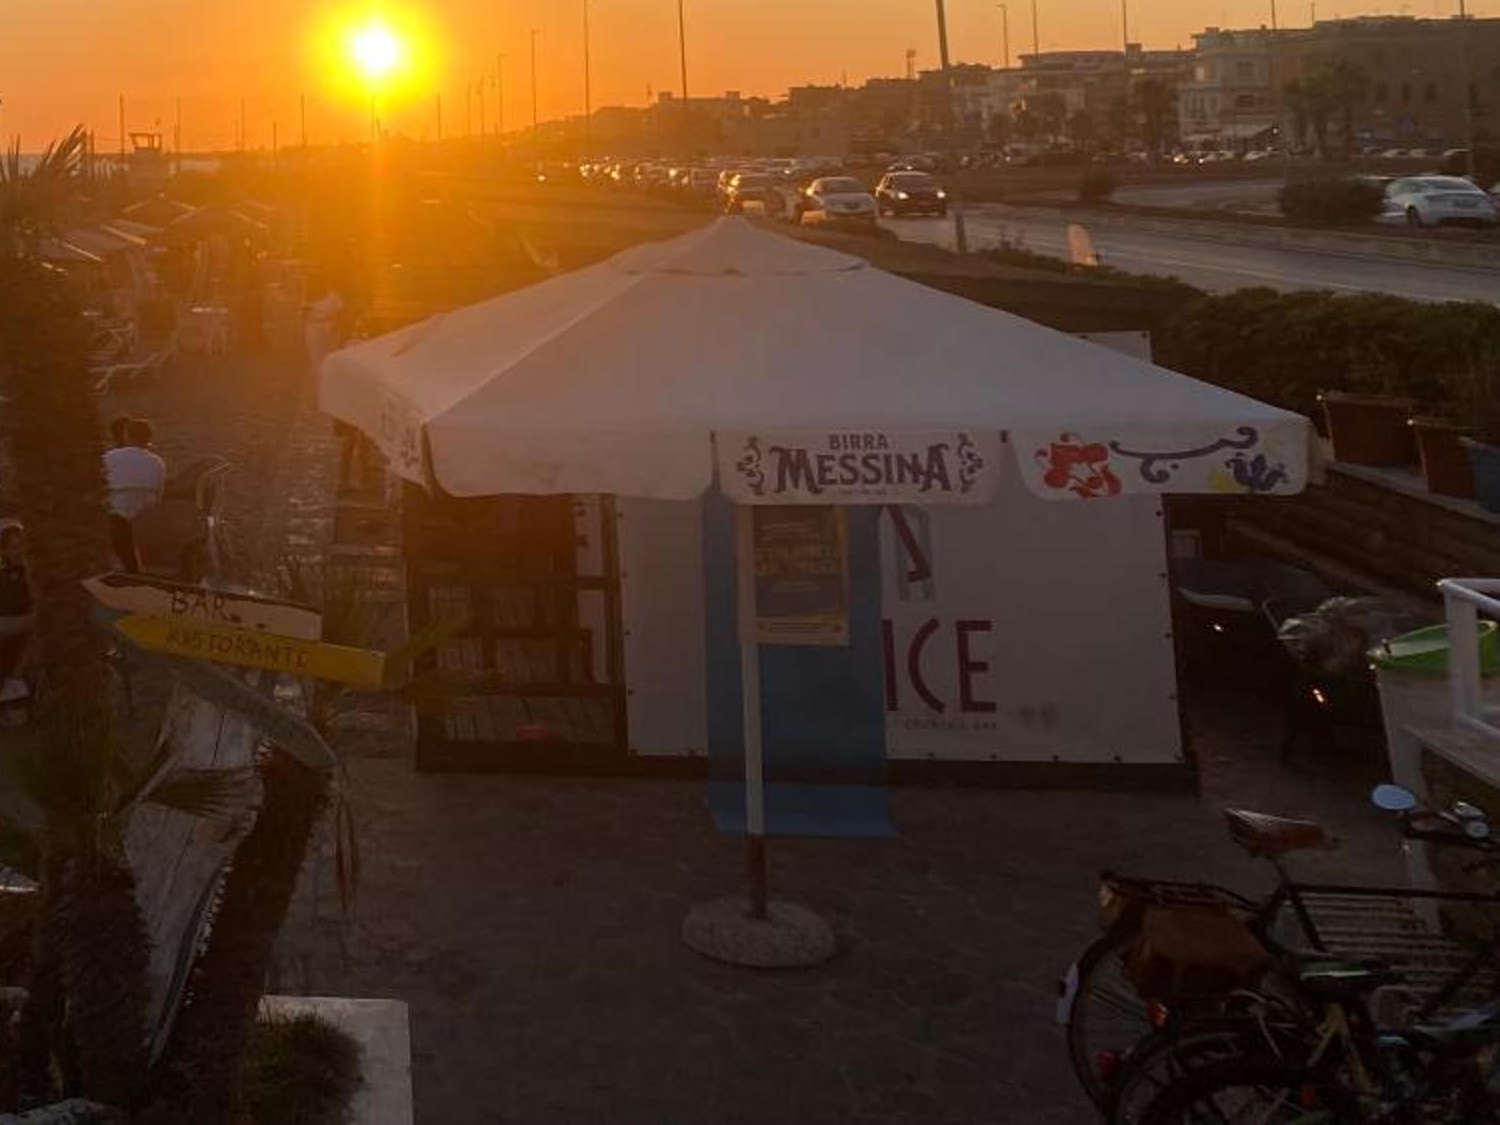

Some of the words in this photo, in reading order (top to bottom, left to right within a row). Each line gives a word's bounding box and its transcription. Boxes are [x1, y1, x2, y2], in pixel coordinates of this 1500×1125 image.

[829, 434, 889, 450] BIRRA
[769, 443, 951, 495] MESSINA
[171, 588, 229, 620] BAR
